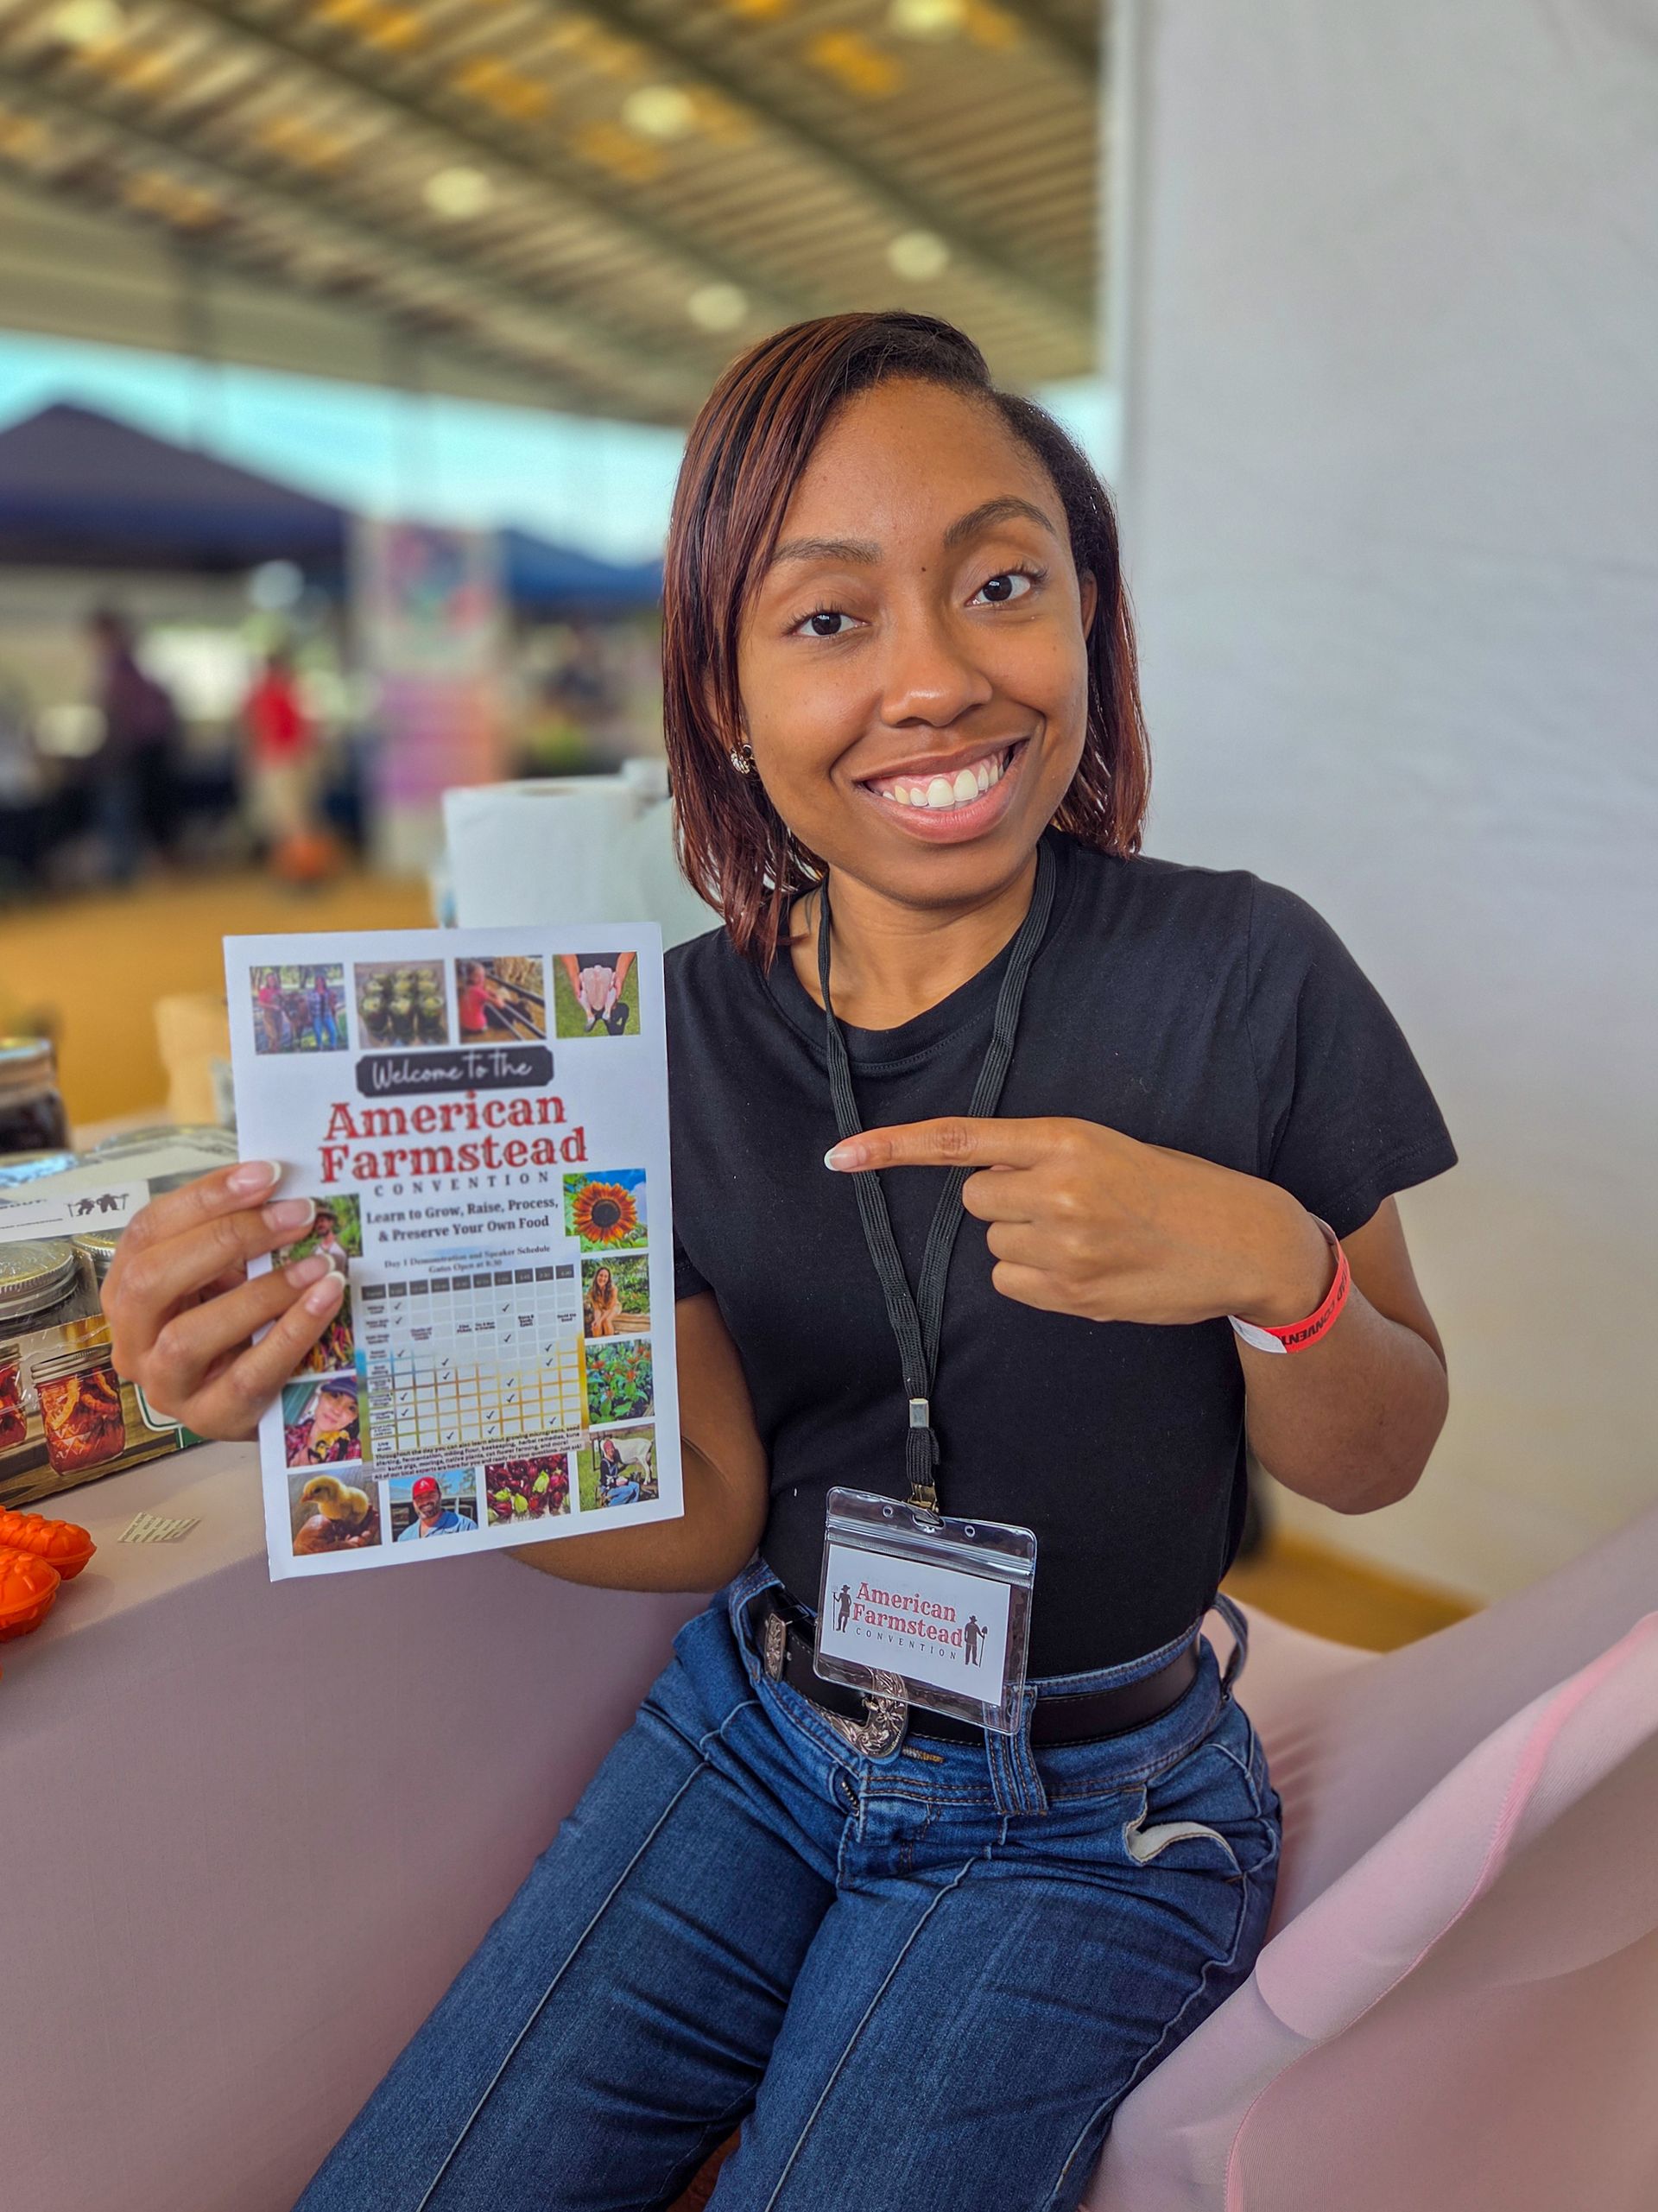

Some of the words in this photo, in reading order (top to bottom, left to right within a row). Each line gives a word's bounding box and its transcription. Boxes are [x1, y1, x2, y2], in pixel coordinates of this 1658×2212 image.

[371, 1060, 463, 1090] Welcome
[323, 1088, 566, 1141] American
[318, 1126, 589, 1182] Farmstead
[375, 1171, 550, 1196] CONVENTION
[366, 1212, 406, 1224] Learn
[408, 1209, 421, 1220] to
[425, 1206, 465, 1219] Grow,
[467, 1201, 504, 1214] Raise,
[508, 1198, 559, 1211] Process,
[378, 1230, 389, 1242] &
[392, 1226, 449, 1241] Preserve
[452, 1222, 484, 1236] Your
[487, 1220, 516, 1232] Own
[519, 1214, 549, 1229] Food
[384, 1260, 400, 1269] Day
[484, 1249, 515, 1259] Speaker
[517, 1244, 551, 1254] Schedule
[453, 1262, 474, 1272] Open
[856, 1581, 956, 1624] American
[851, 1602, 963, 1649] Farmstead
[856, 1627, 958, 1661] CONVENTION
